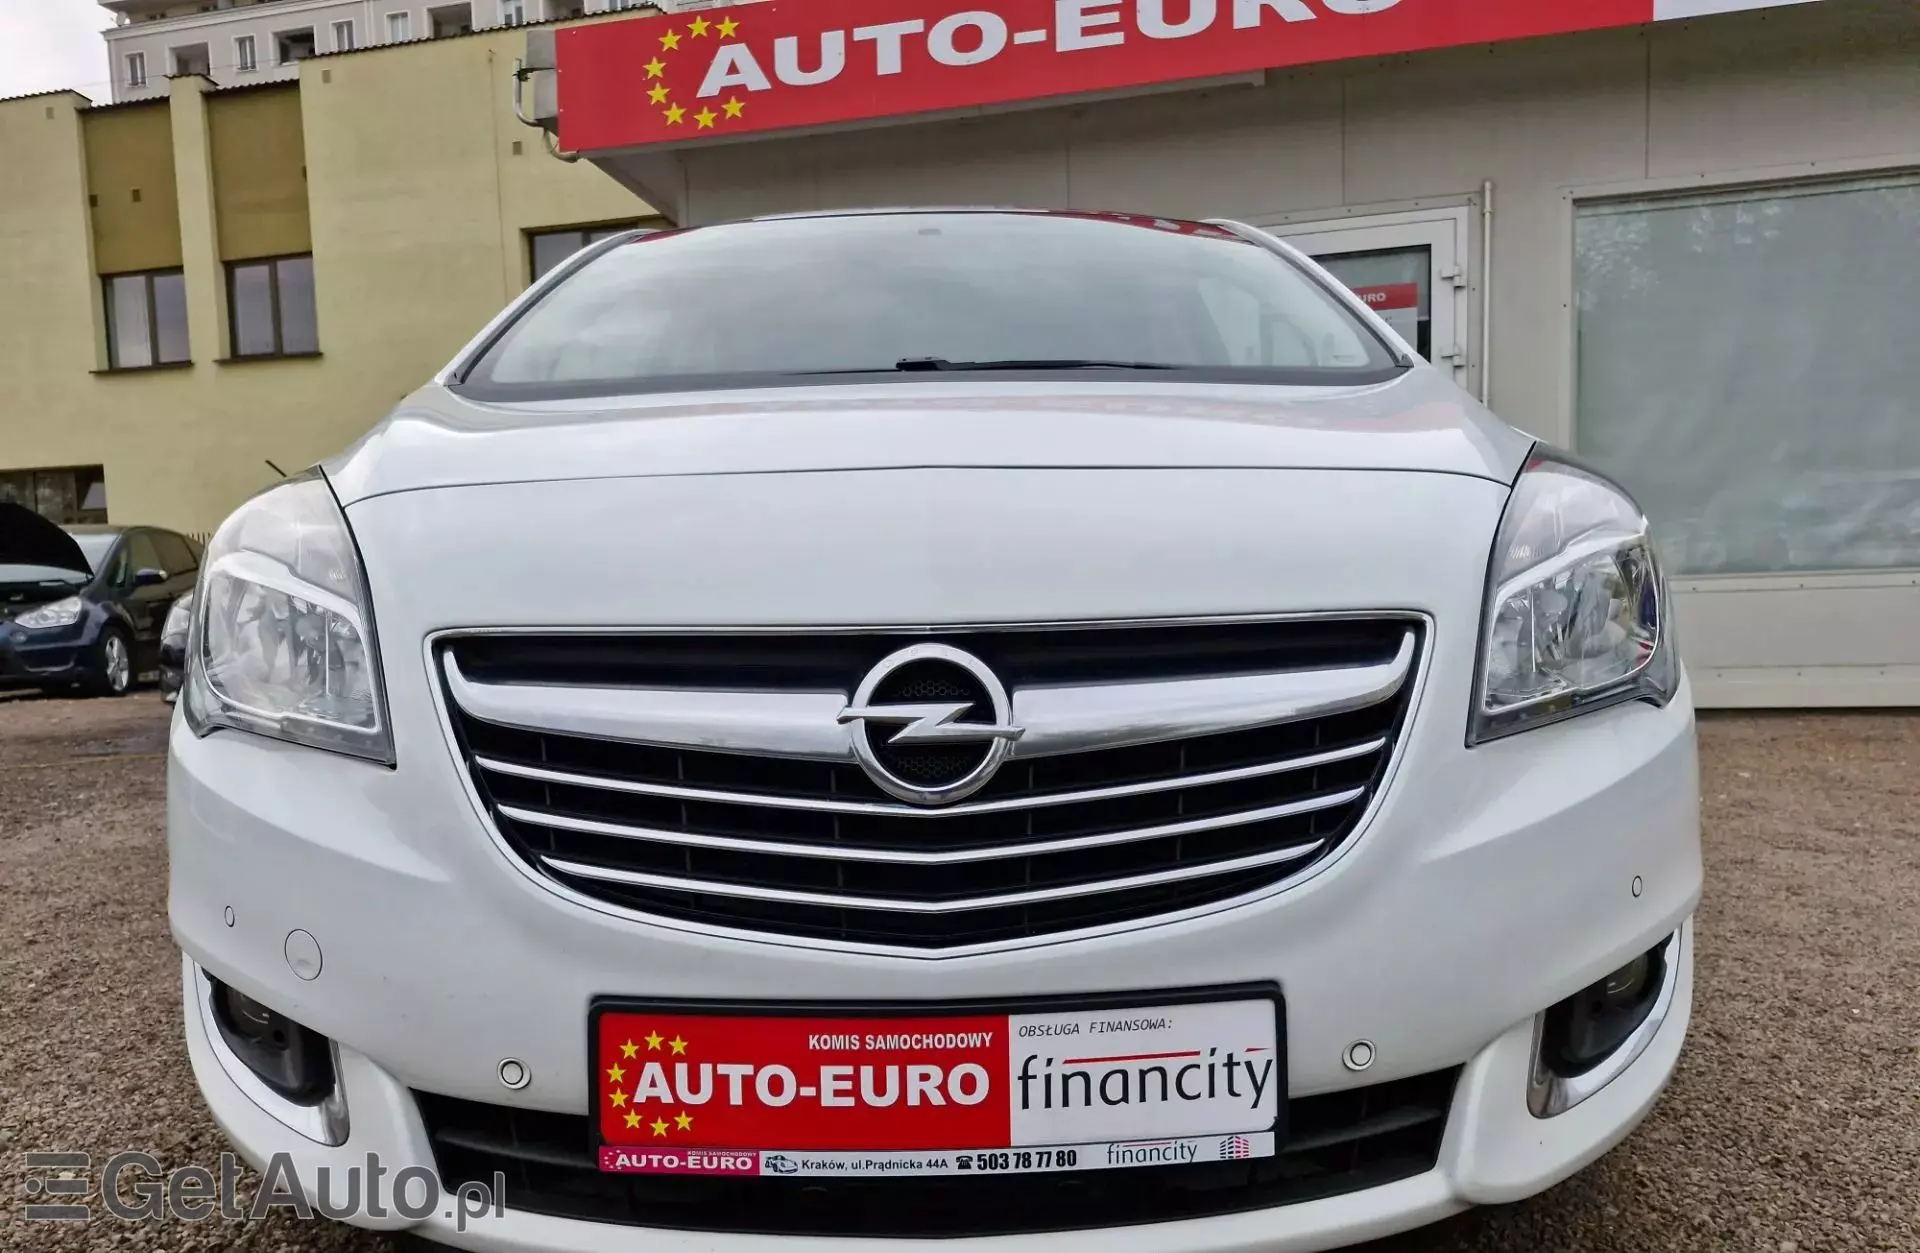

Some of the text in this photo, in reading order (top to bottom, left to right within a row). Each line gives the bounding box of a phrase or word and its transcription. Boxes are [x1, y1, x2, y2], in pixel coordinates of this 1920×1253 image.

[1018, 1018, 1173, 1037] OBSŁUGA FINANSOWA:
[808, 1032, 993, 1050] KOMIS SAMOCHODOWY
[633, 1062, 990, 1107] AUTO-EURO
[1017, 1047, 1273, 1110] financity
[615, 1154, 752, 1170] AUTO-EURO
[977, 1150, 1077, 1170] 503 78 77 80
[1107, 1142, 1198, 1164] financity
[802, 1159, 848, 1171] Kraków,
[926, 1159, 949, 1169] 44A
